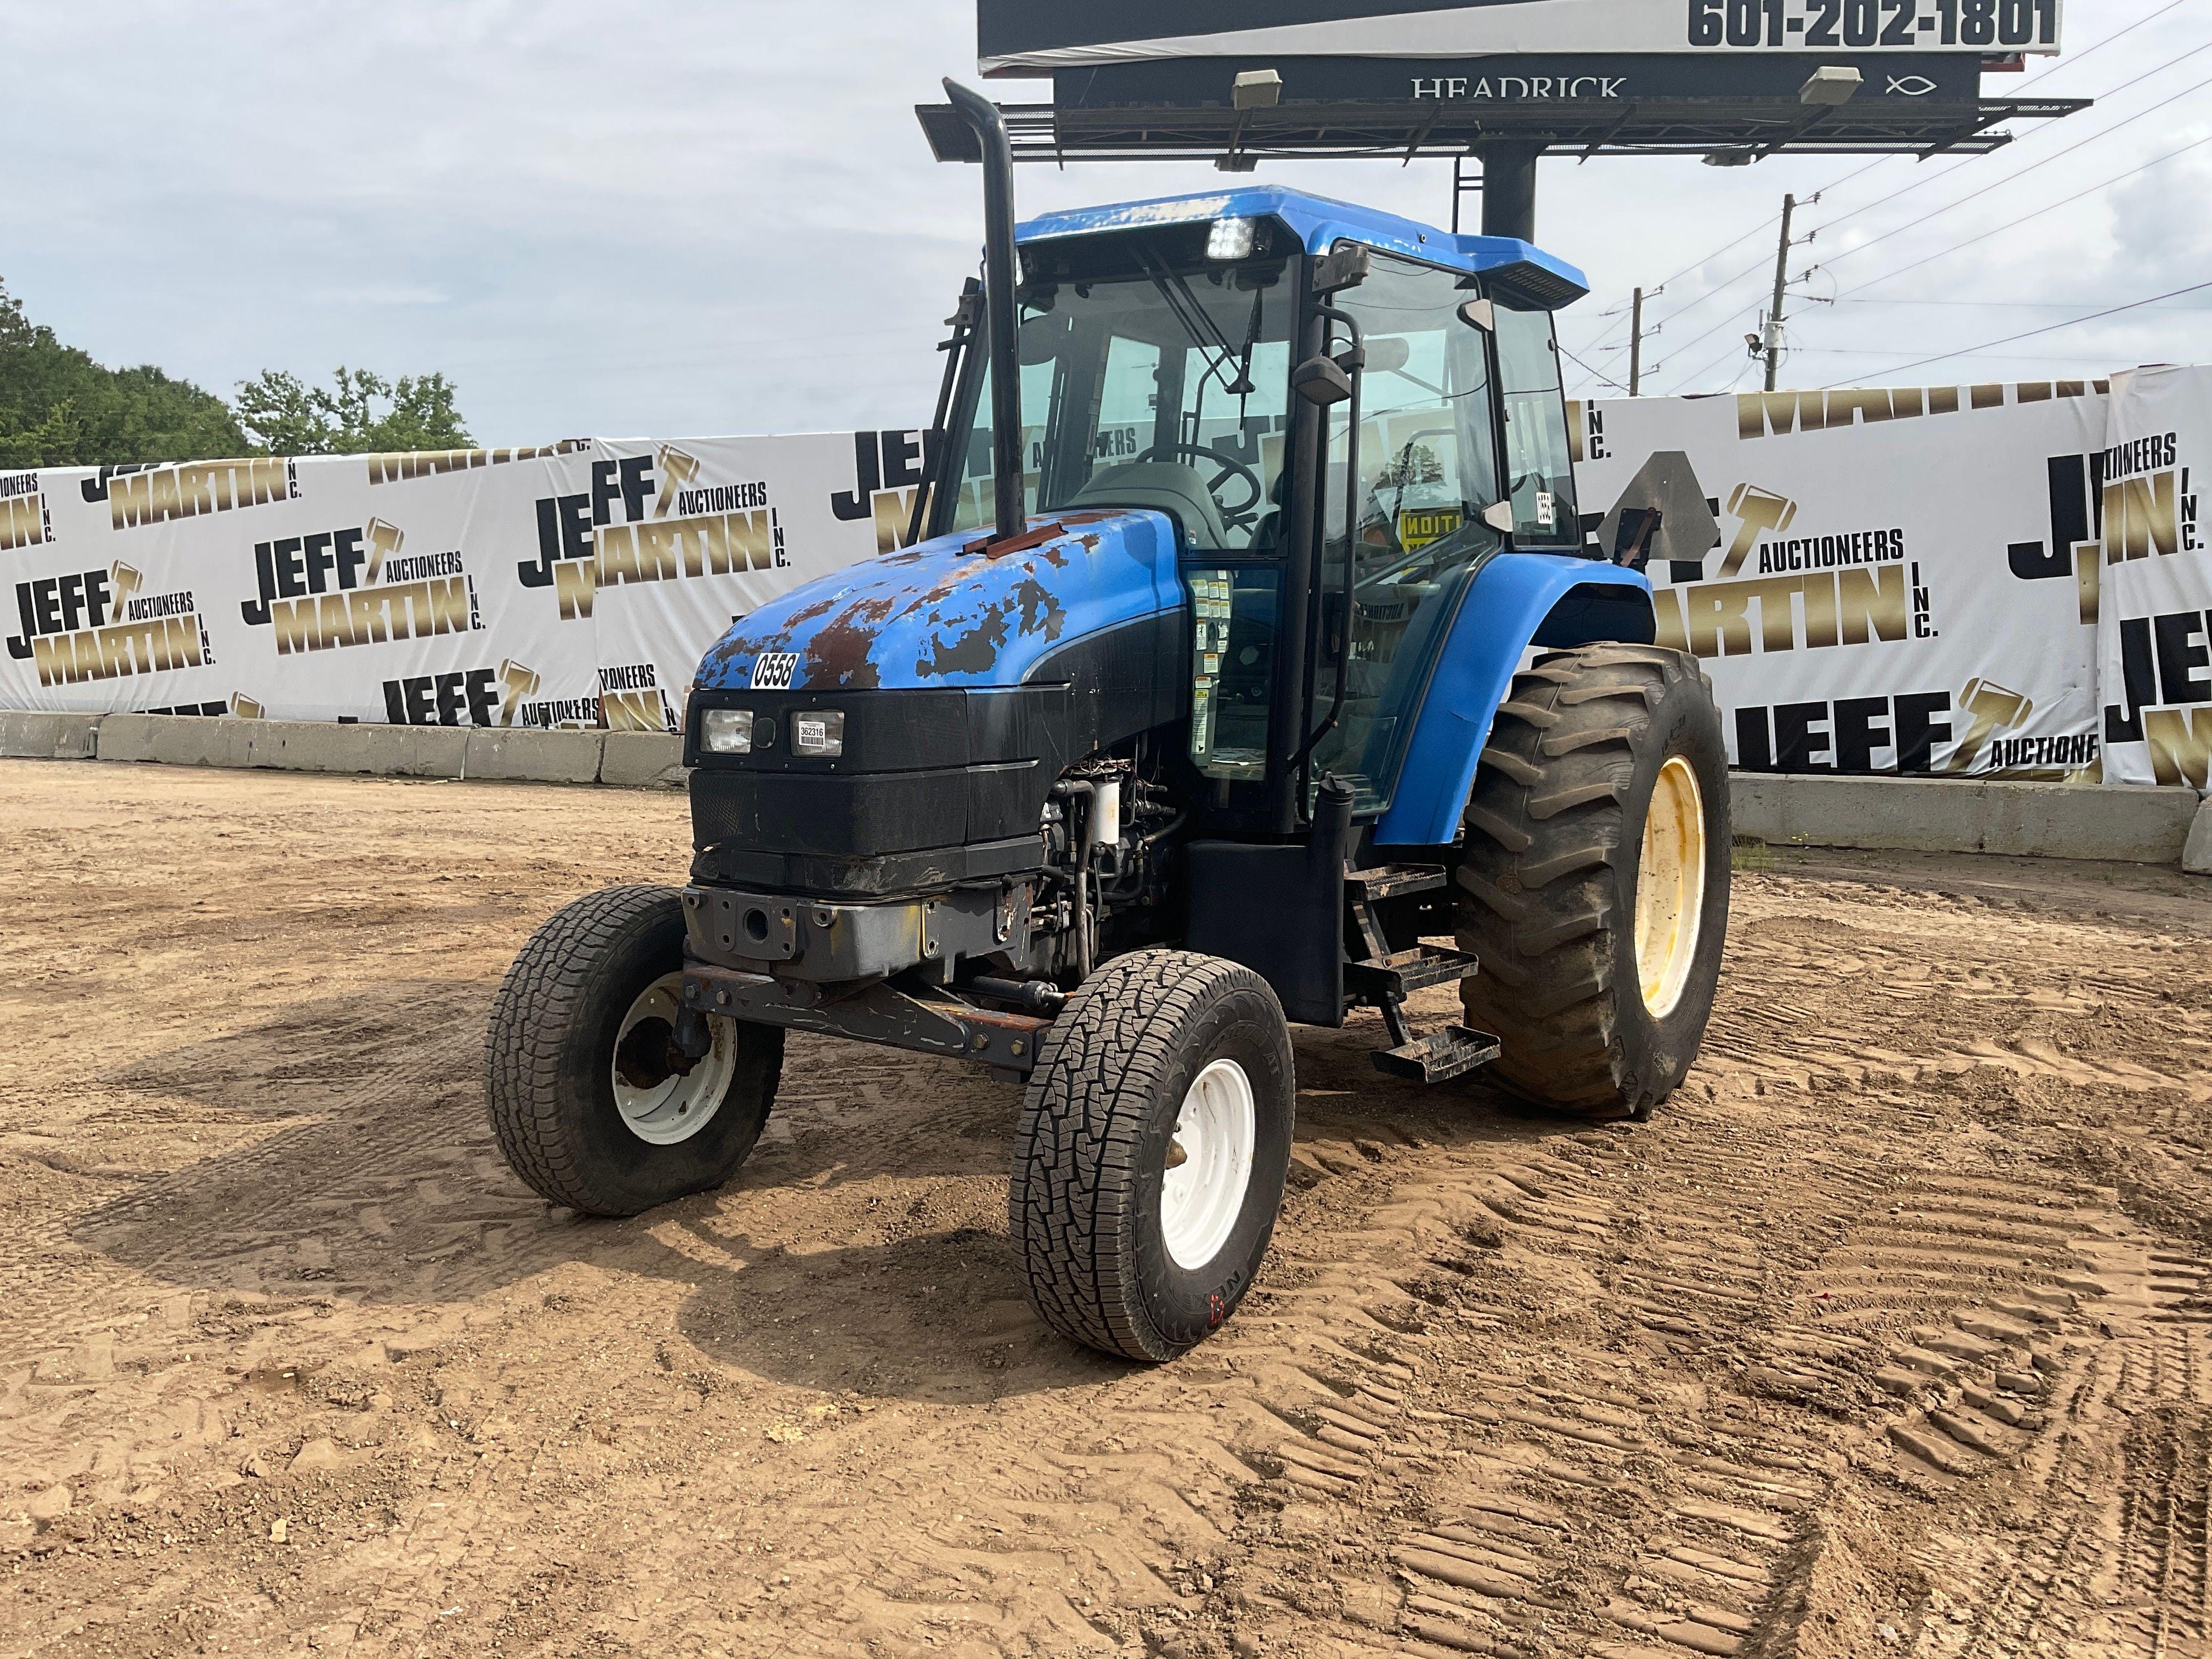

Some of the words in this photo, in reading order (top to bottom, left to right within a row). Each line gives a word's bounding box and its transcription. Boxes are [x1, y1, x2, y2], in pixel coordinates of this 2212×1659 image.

[1687, 0, 2056, 47] 601-202-1801
[1410, 77, 1627, 98] HEADRICK
[41, 493, 56, 543] INC.
[109, 456, 287, 531] MARTIN
[679, 481, 767, 516] AUCTIONEERS
[2181, 467, 2204, 551] INC.
[771, 507, 791, 567] INC.
[1759, 528, 1904, 574] AUCTIONEERS
[241, 527, 365, 625] JEFF
[386, 550, 464, 584] AUCTIONEERS
[6, 569, 111, 659] JEFF
[128, 591, 195, 622] AUCTIONEERS
[272, 577, 469, 656] MARTIN
[467, 574, 486, 631] INC.
[1911, 561, 1939, 639] INC.
[33, 614, 202, 687] MARTIN
[198, 613, 216, 665] INC.
[754, 653, 798, 687] 0558
[2104, 609, 2212, 744] JE
[801, 727, 823, 736] 362316
